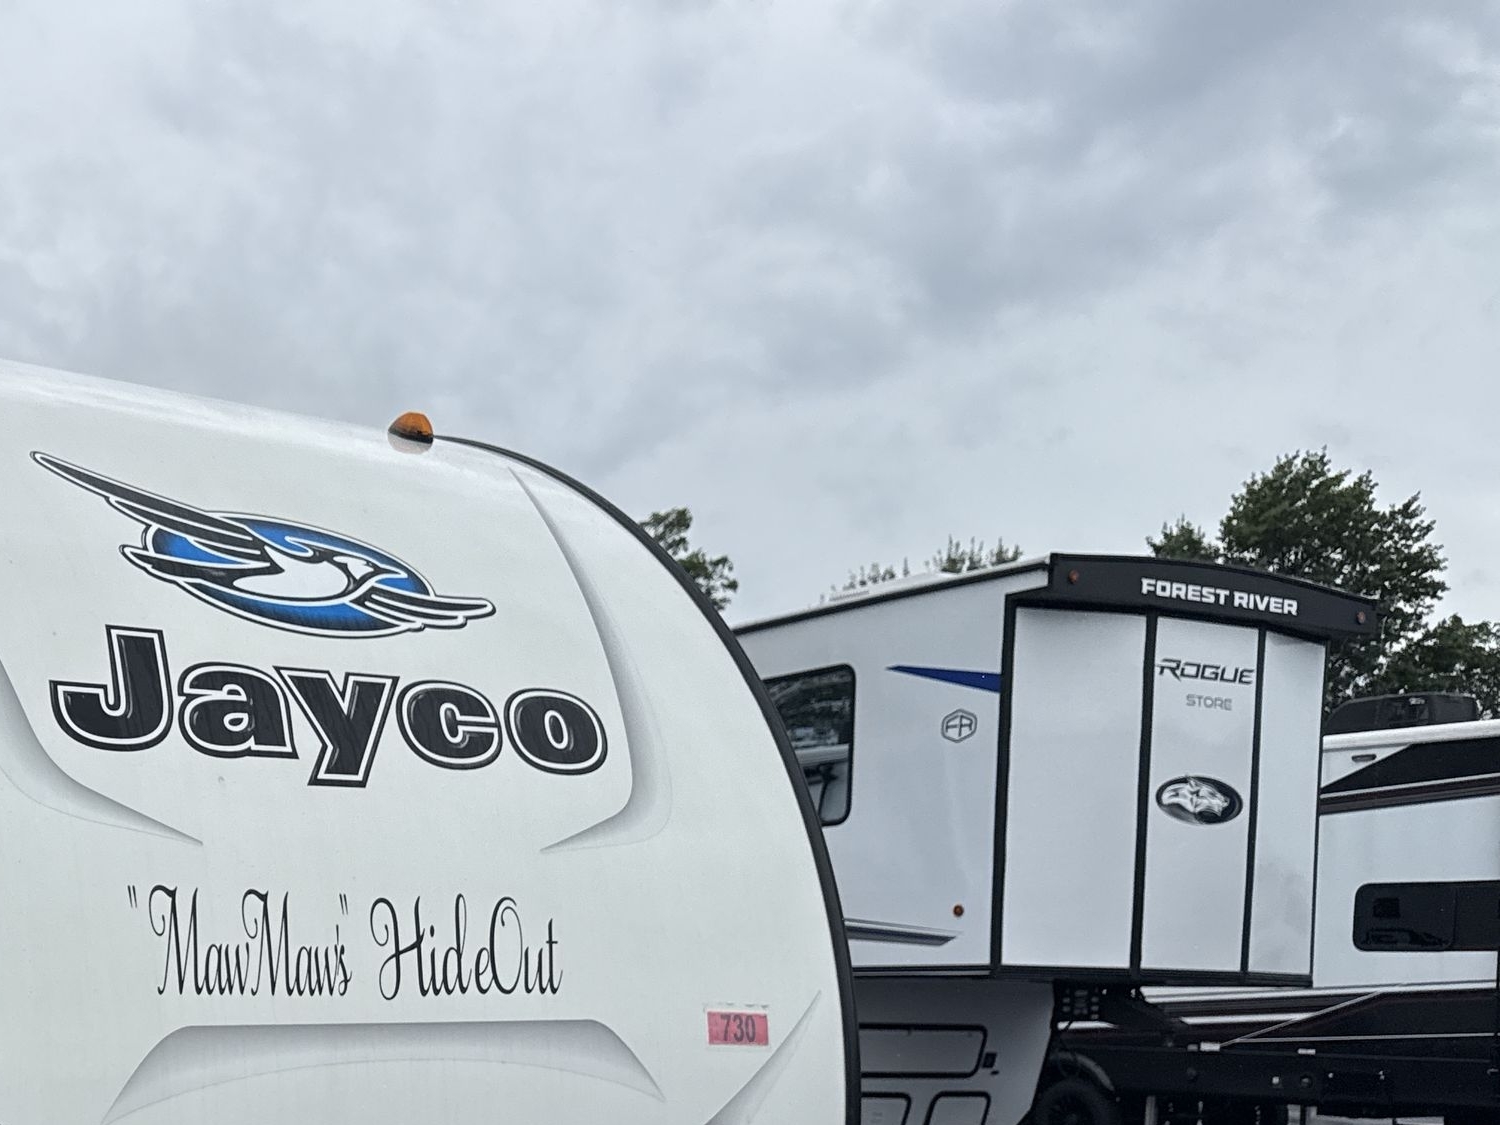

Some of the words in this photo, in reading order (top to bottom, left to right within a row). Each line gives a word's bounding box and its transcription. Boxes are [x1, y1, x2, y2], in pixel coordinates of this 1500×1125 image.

[1141, 577, 1229, 605] FOREST
[1233, 591, 1298, 616] RIVER
[1155, 657, 1255, 685] ROGUE
[49, 624, 608, 787] Jayco
[370, 893, 564, 1001] HideOut
[720, 1013, 756, 1043] 730
